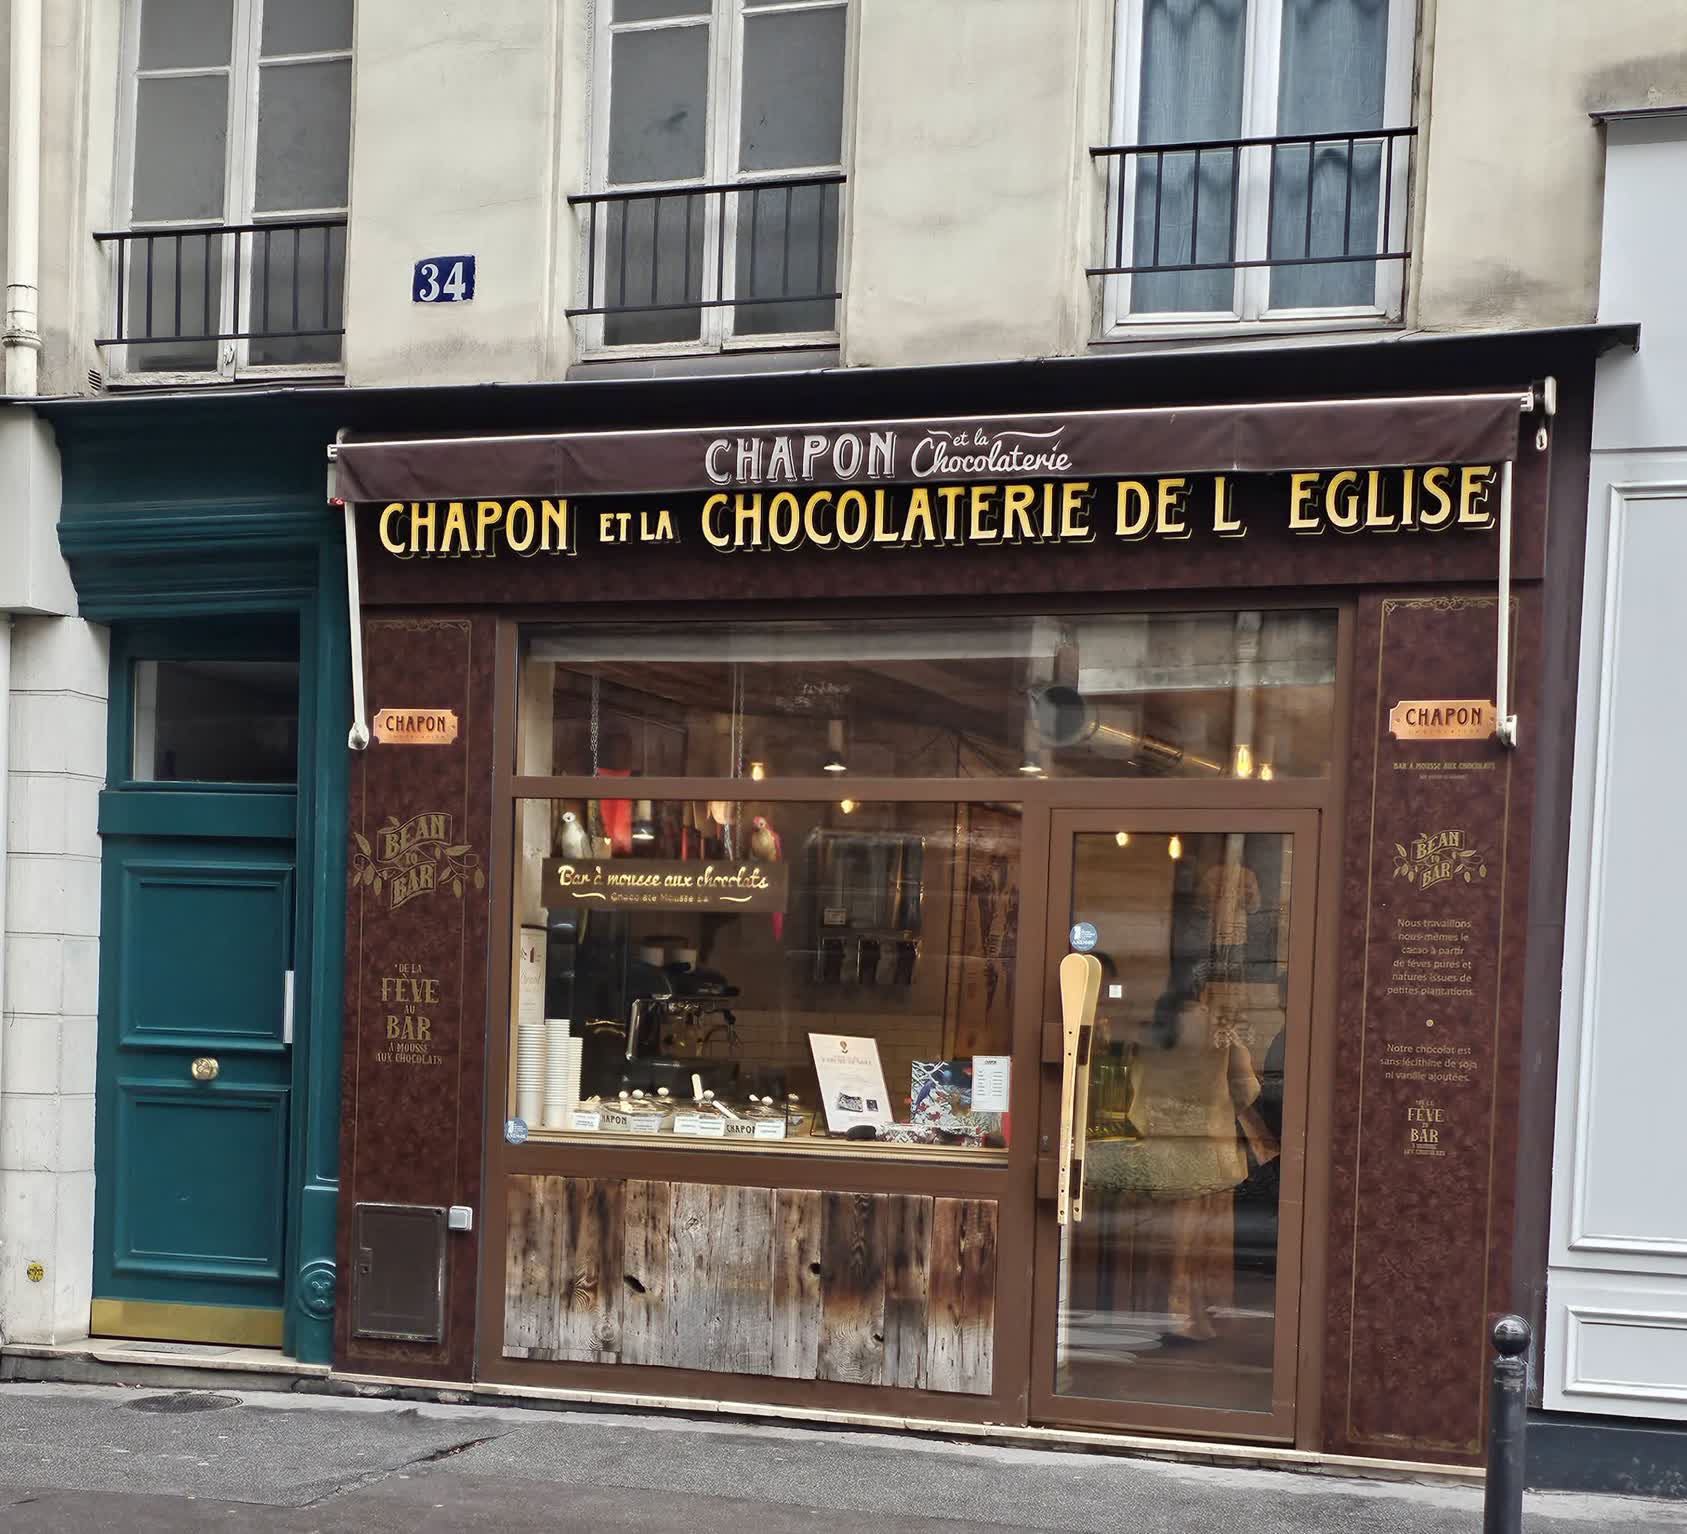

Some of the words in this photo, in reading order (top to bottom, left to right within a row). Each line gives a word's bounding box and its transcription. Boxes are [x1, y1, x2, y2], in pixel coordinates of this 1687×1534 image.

[419, 261, 466, 302] 34
[953, 432, 970, 447] et
[974, 427, 989, 446] la
[704, 431, 896, 485] CHAPON
[911, 437, 1073, 478] Chocolaterie
[379, 500, 577, 558] CHAPON
[600, 512, 638, 543] ET
[640, 510, 680, 543] LA
[701, 481, 1096, 553] CHOCOLATERIE
[1115, 476, 1192, 540] DE
[1288, 466, 1497, 534] EGLISE
[386, 715, 446, 732] CHAPON
[1405, 708, 1482, 727] CHAPON
[385, 815, 446, 859] BEAN
[1417, 832, 1460, 859] BEAN
[393, 864, 434, 904] BAR
[558, 865, 590, 886] Bar
[607, 873, 660, 887] mousse
[664, 873, 693, 887] aux
[697, 865, 769, 889] chocolats
[1422, 863, 1450, 887] BAR
[1397, 919, 1421, 928] Nous
[1424, 920, 1472, 928] travaillons
[1460, 933, 1469, 941] le
[1402, 946, 1428, 954] cacao
[1439, 946, 1464, 956] partir
[399, 964, 409, 973] DE
[411, 963, 422, 973] LA
[1393, 959, 1405, 967] de
[1433, 961, 1460, 969] pures
[1462, 961, 1472, 969] et
[1392, 972, 1427, 981] natures
[1459, 974, 1472, 982] de
[382, 973, 440, 1003] FÈVE
[1421, 987, 1472, 996] plantations
[404, 1005, 415, 1014] AU
[387, 1015, 431, 1040] BAR
[1387, 1044, 1413, 1053] Notre
[1416, 1045, 1454, 1054] chocolat
[1444, 1059, 1457, 1068] de
[1411, 1128, 1439, 1142] BAR
